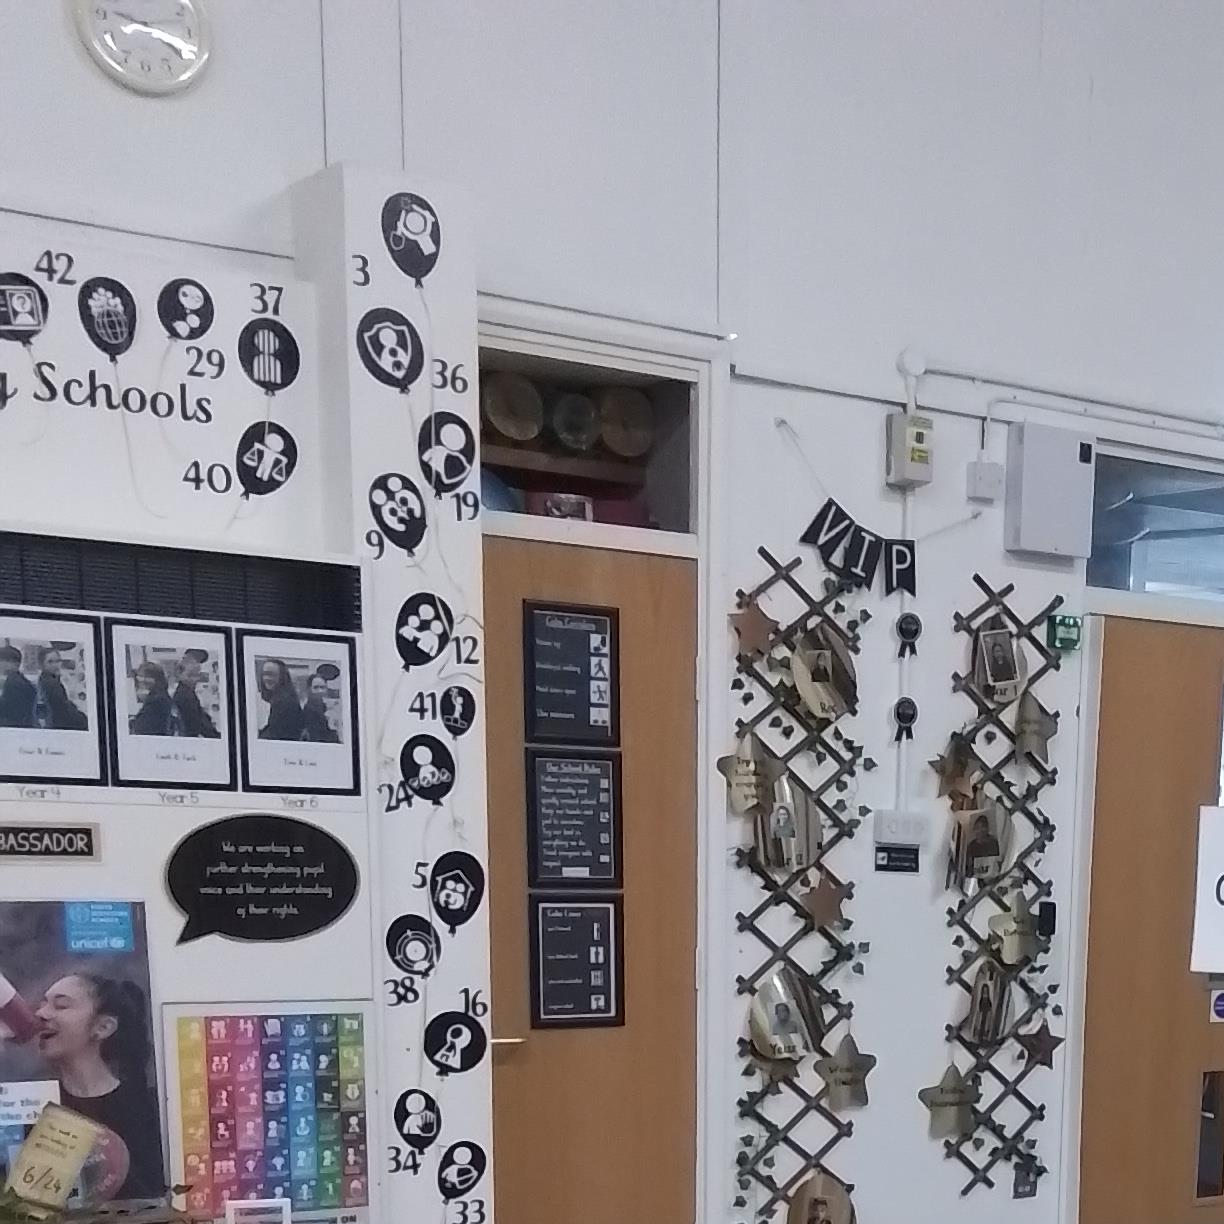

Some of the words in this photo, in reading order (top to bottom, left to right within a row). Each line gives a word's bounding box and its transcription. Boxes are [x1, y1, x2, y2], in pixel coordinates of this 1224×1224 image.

[35, 250, 76, 286] 42
[352, 255, 370, 286] 3
[250, 283, 283, 316] 37
[186, 347, 226, 379] 29
[433, 359, 468, 393] 36
[33, 361, 213, 423] Schools
[183, 461, 232, 494] 40
[453, 491, 480, 522] 19
[365, 530, 384, 561] 9
[817, 505, 911, 579] VIP
[451, 636, 480, 665] 12
[409, 692, 438, 720] 41
[17, 786, 47, 799] Year
[158, 791, 185, 804] Year
[280, 796, 305, 808] Year
[378, 783, 414, 813] 24
[412, 862, 430, 890] 5
[71, 936, 109, 949] unicef
[384, 979, 419, 1006] 38
[460, 988, 488, 1016] 16
[388, 1145, 421, 1176] 34
[23, 1166, 61, 1193] 6/24
